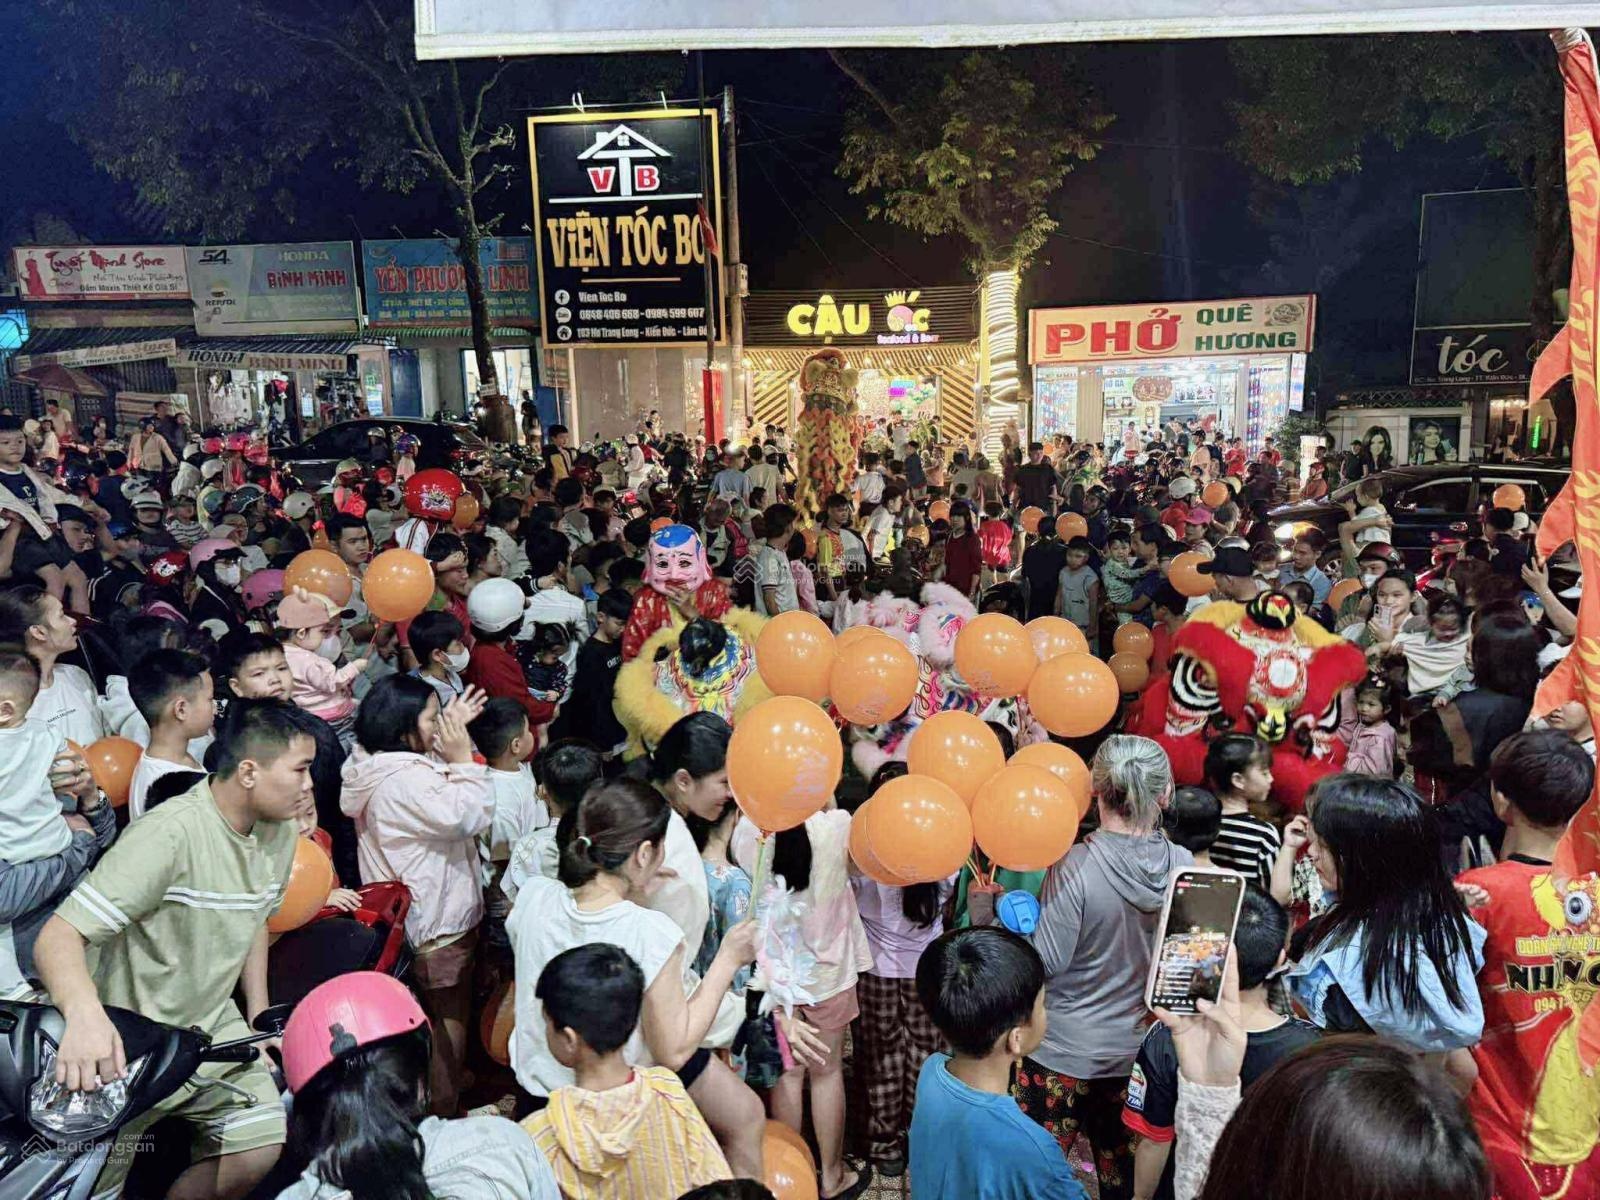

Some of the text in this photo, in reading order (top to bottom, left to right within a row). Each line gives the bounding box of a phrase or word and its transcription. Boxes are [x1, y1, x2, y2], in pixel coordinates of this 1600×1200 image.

[615, 206, 668, 266] TÓC
[278, 251, 329, 262] HONDA
[488, 264, 530, 293] LINH
[787, 295, 870, 344] CẬU
[1196, 303, 1252, 326] QUÊ
[1045, 307, 1182, 356] PHỞ
[1195, 331, 1297, 351] HƯƠNG
[188, 350, 246, 363] HONDA
[1436, 334, 1509, 374] tóc
